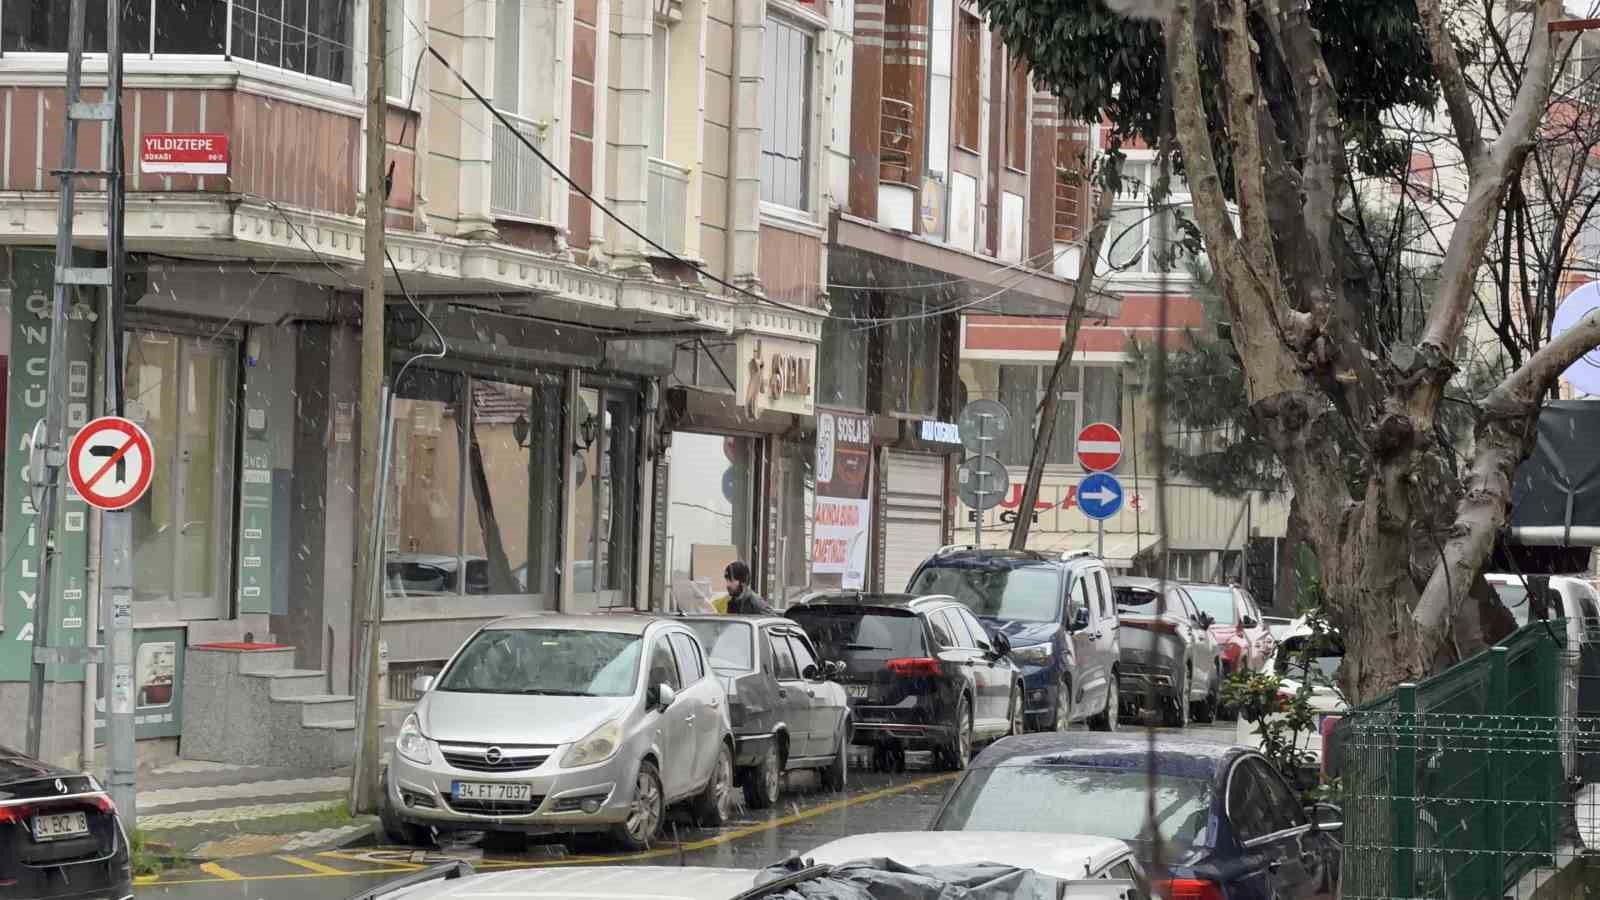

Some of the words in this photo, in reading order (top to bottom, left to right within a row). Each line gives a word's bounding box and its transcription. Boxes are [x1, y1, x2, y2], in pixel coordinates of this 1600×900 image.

[145, 138, 213, 151] YILDIZTEPE
[459, 784, 473, 797] 34
[479, 785, 493, 798] FT
[499, 785, 527, 799] 7037
